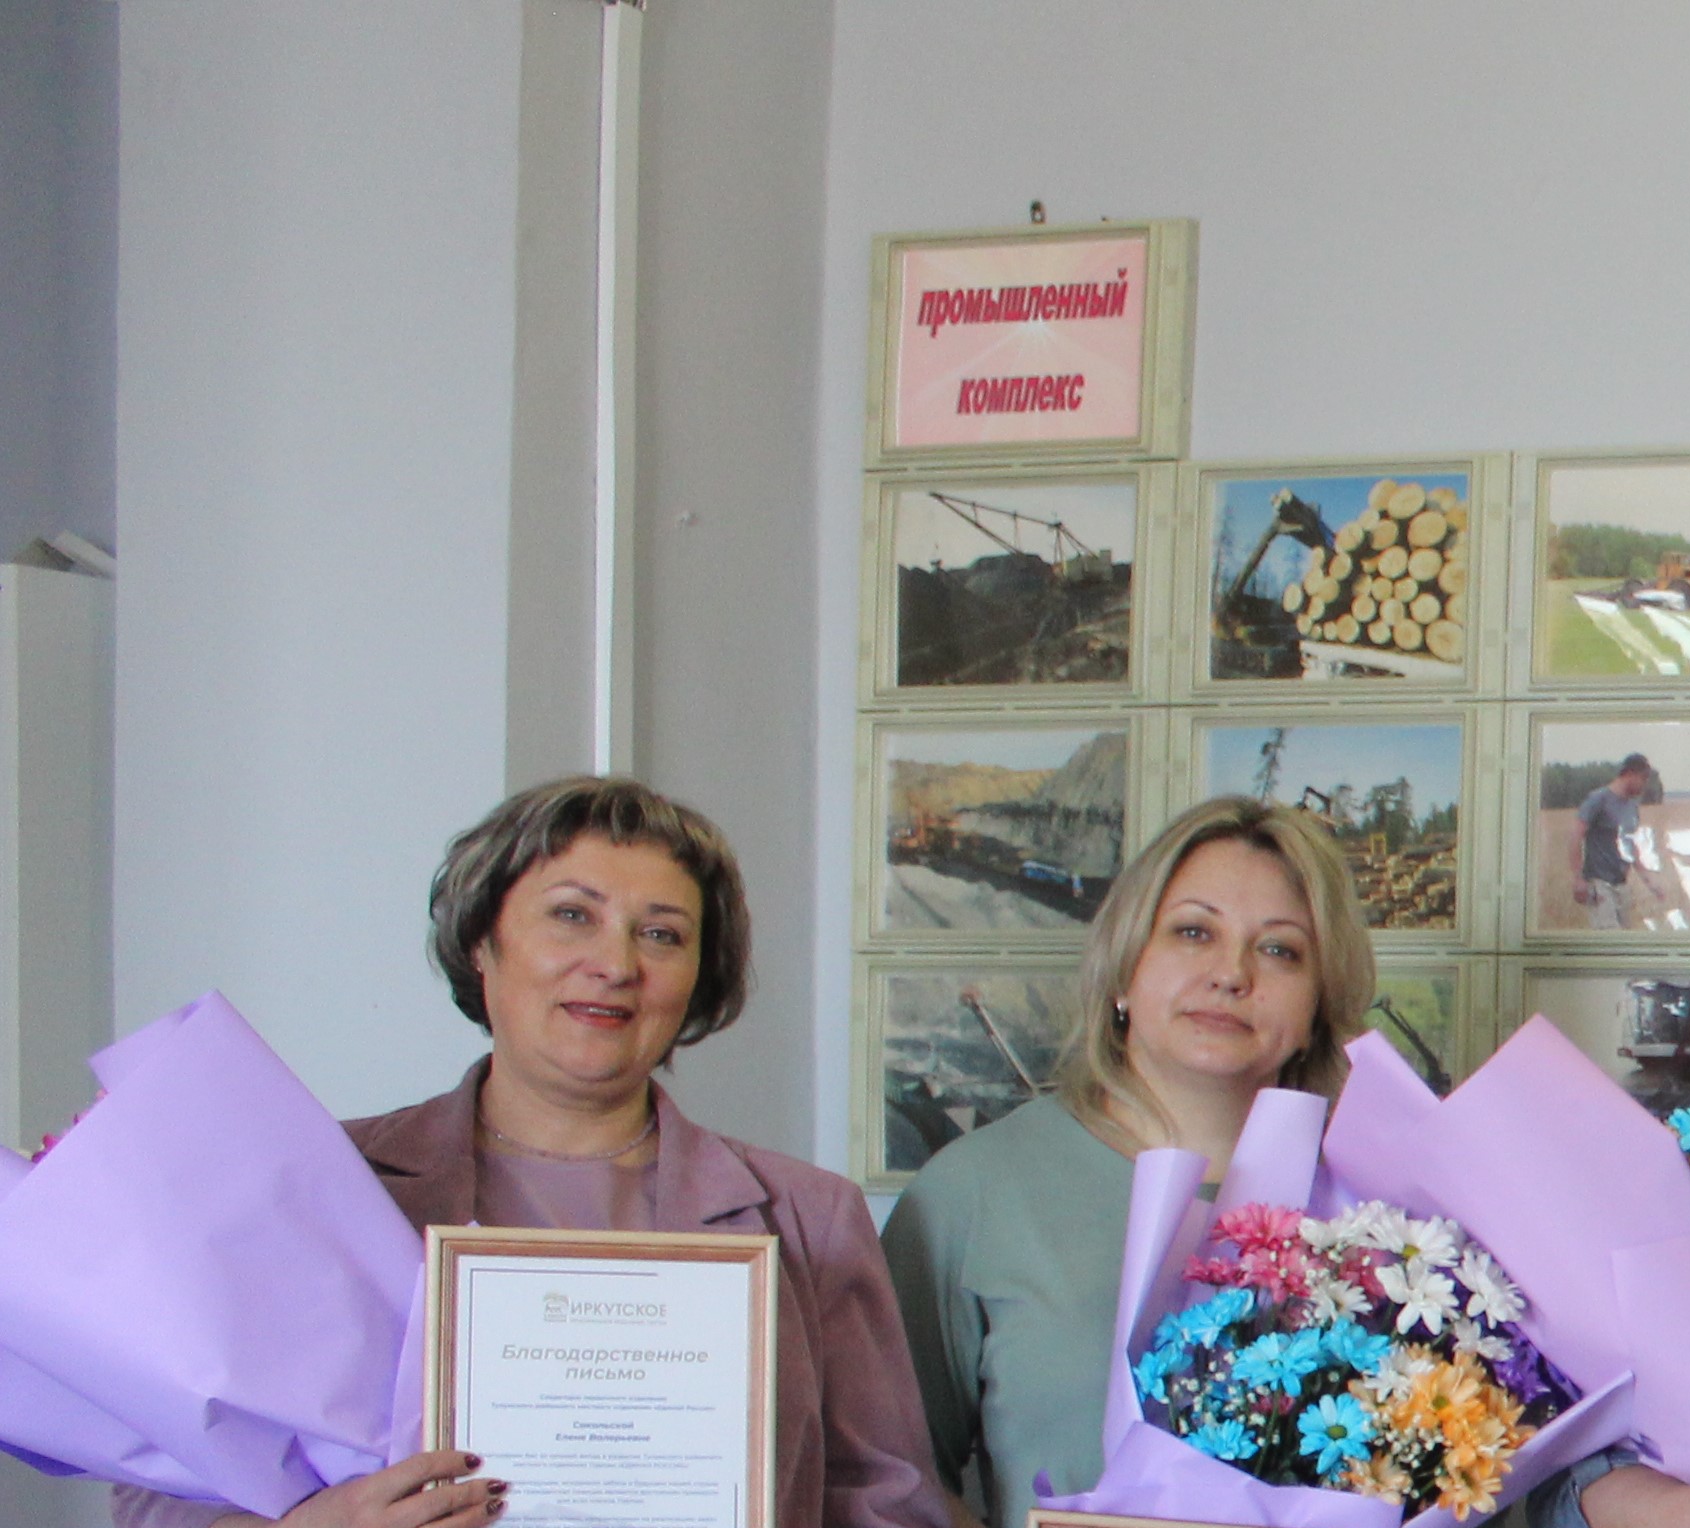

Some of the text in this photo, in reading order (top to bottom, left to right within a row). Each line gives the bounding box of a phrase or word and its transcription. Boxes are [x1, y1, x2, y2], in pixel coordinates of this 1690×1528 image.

[917, 268, 1129, 338] промышленный
[956, 371, 1086, 415] комплекс
[570, 1301, 668, 1318] ИРКУТСКОЕ
[501, 1343, 710, 1365] Благодарственное
[565, 1366, 647, 1382] письмо
